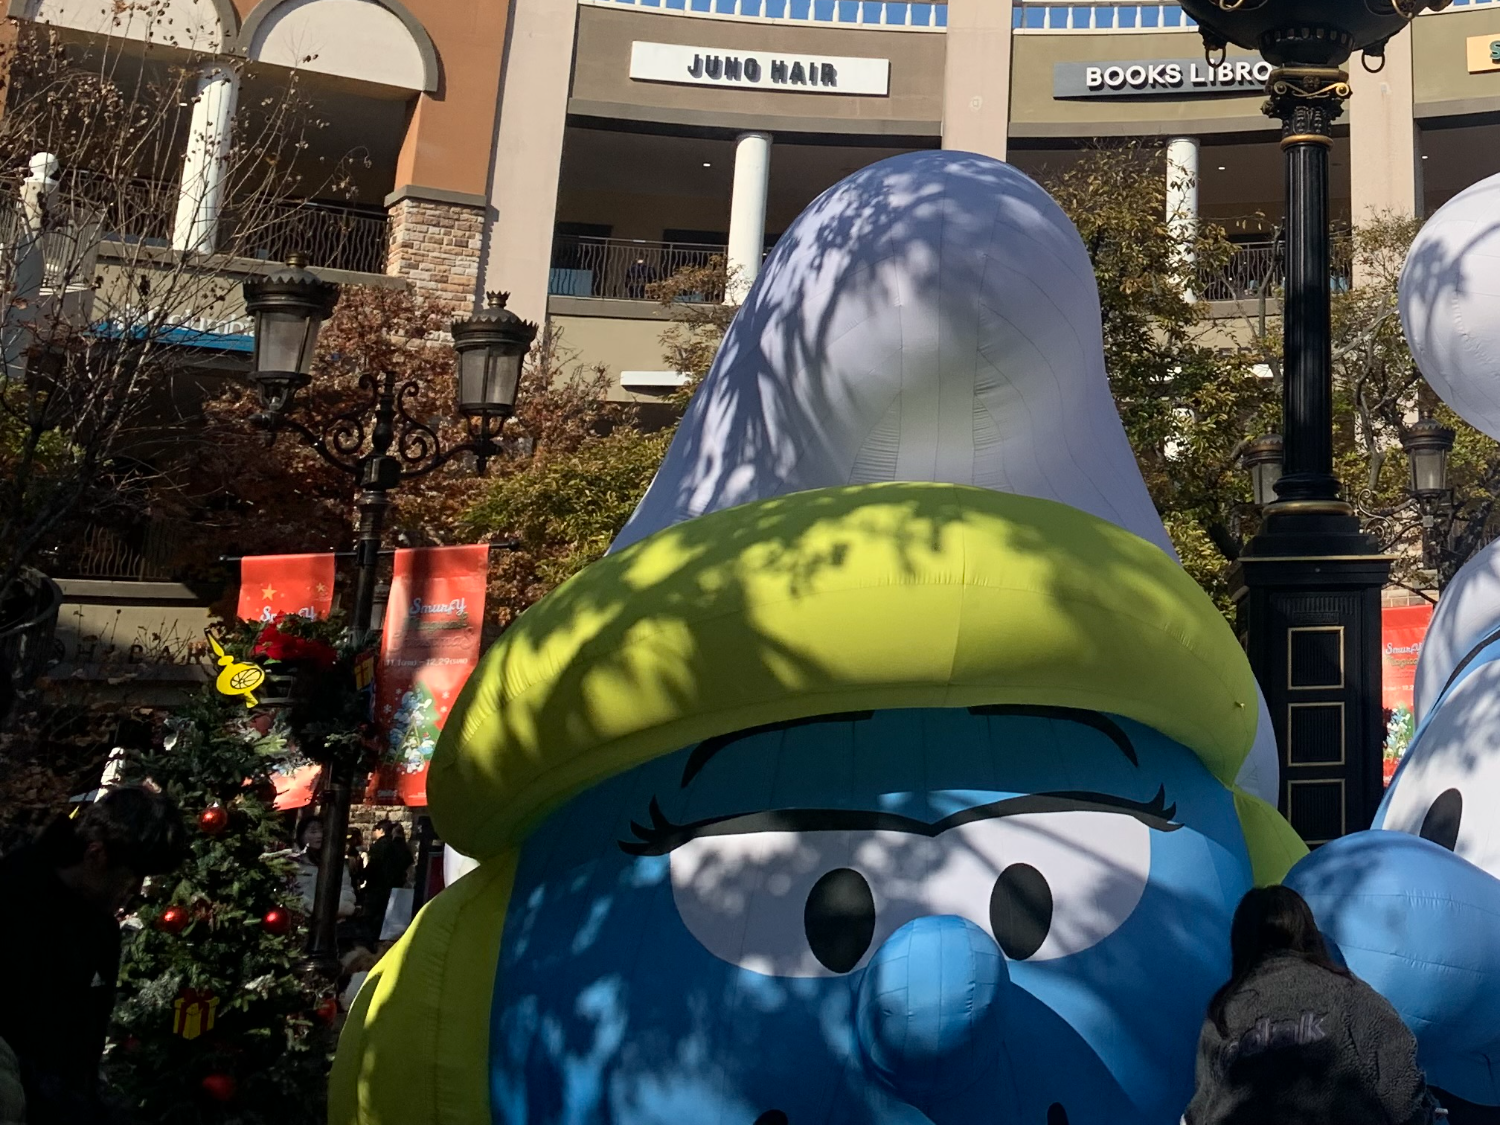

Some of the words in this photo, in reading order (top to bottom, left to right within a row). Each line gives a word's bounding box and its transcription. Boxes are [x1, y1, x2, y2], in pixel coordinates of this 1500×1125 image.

[687, 53, 762, 83] JUNO
[770, 59, 838, 88] HAIR
[1086, 64, 1181, 88] BOOKS
